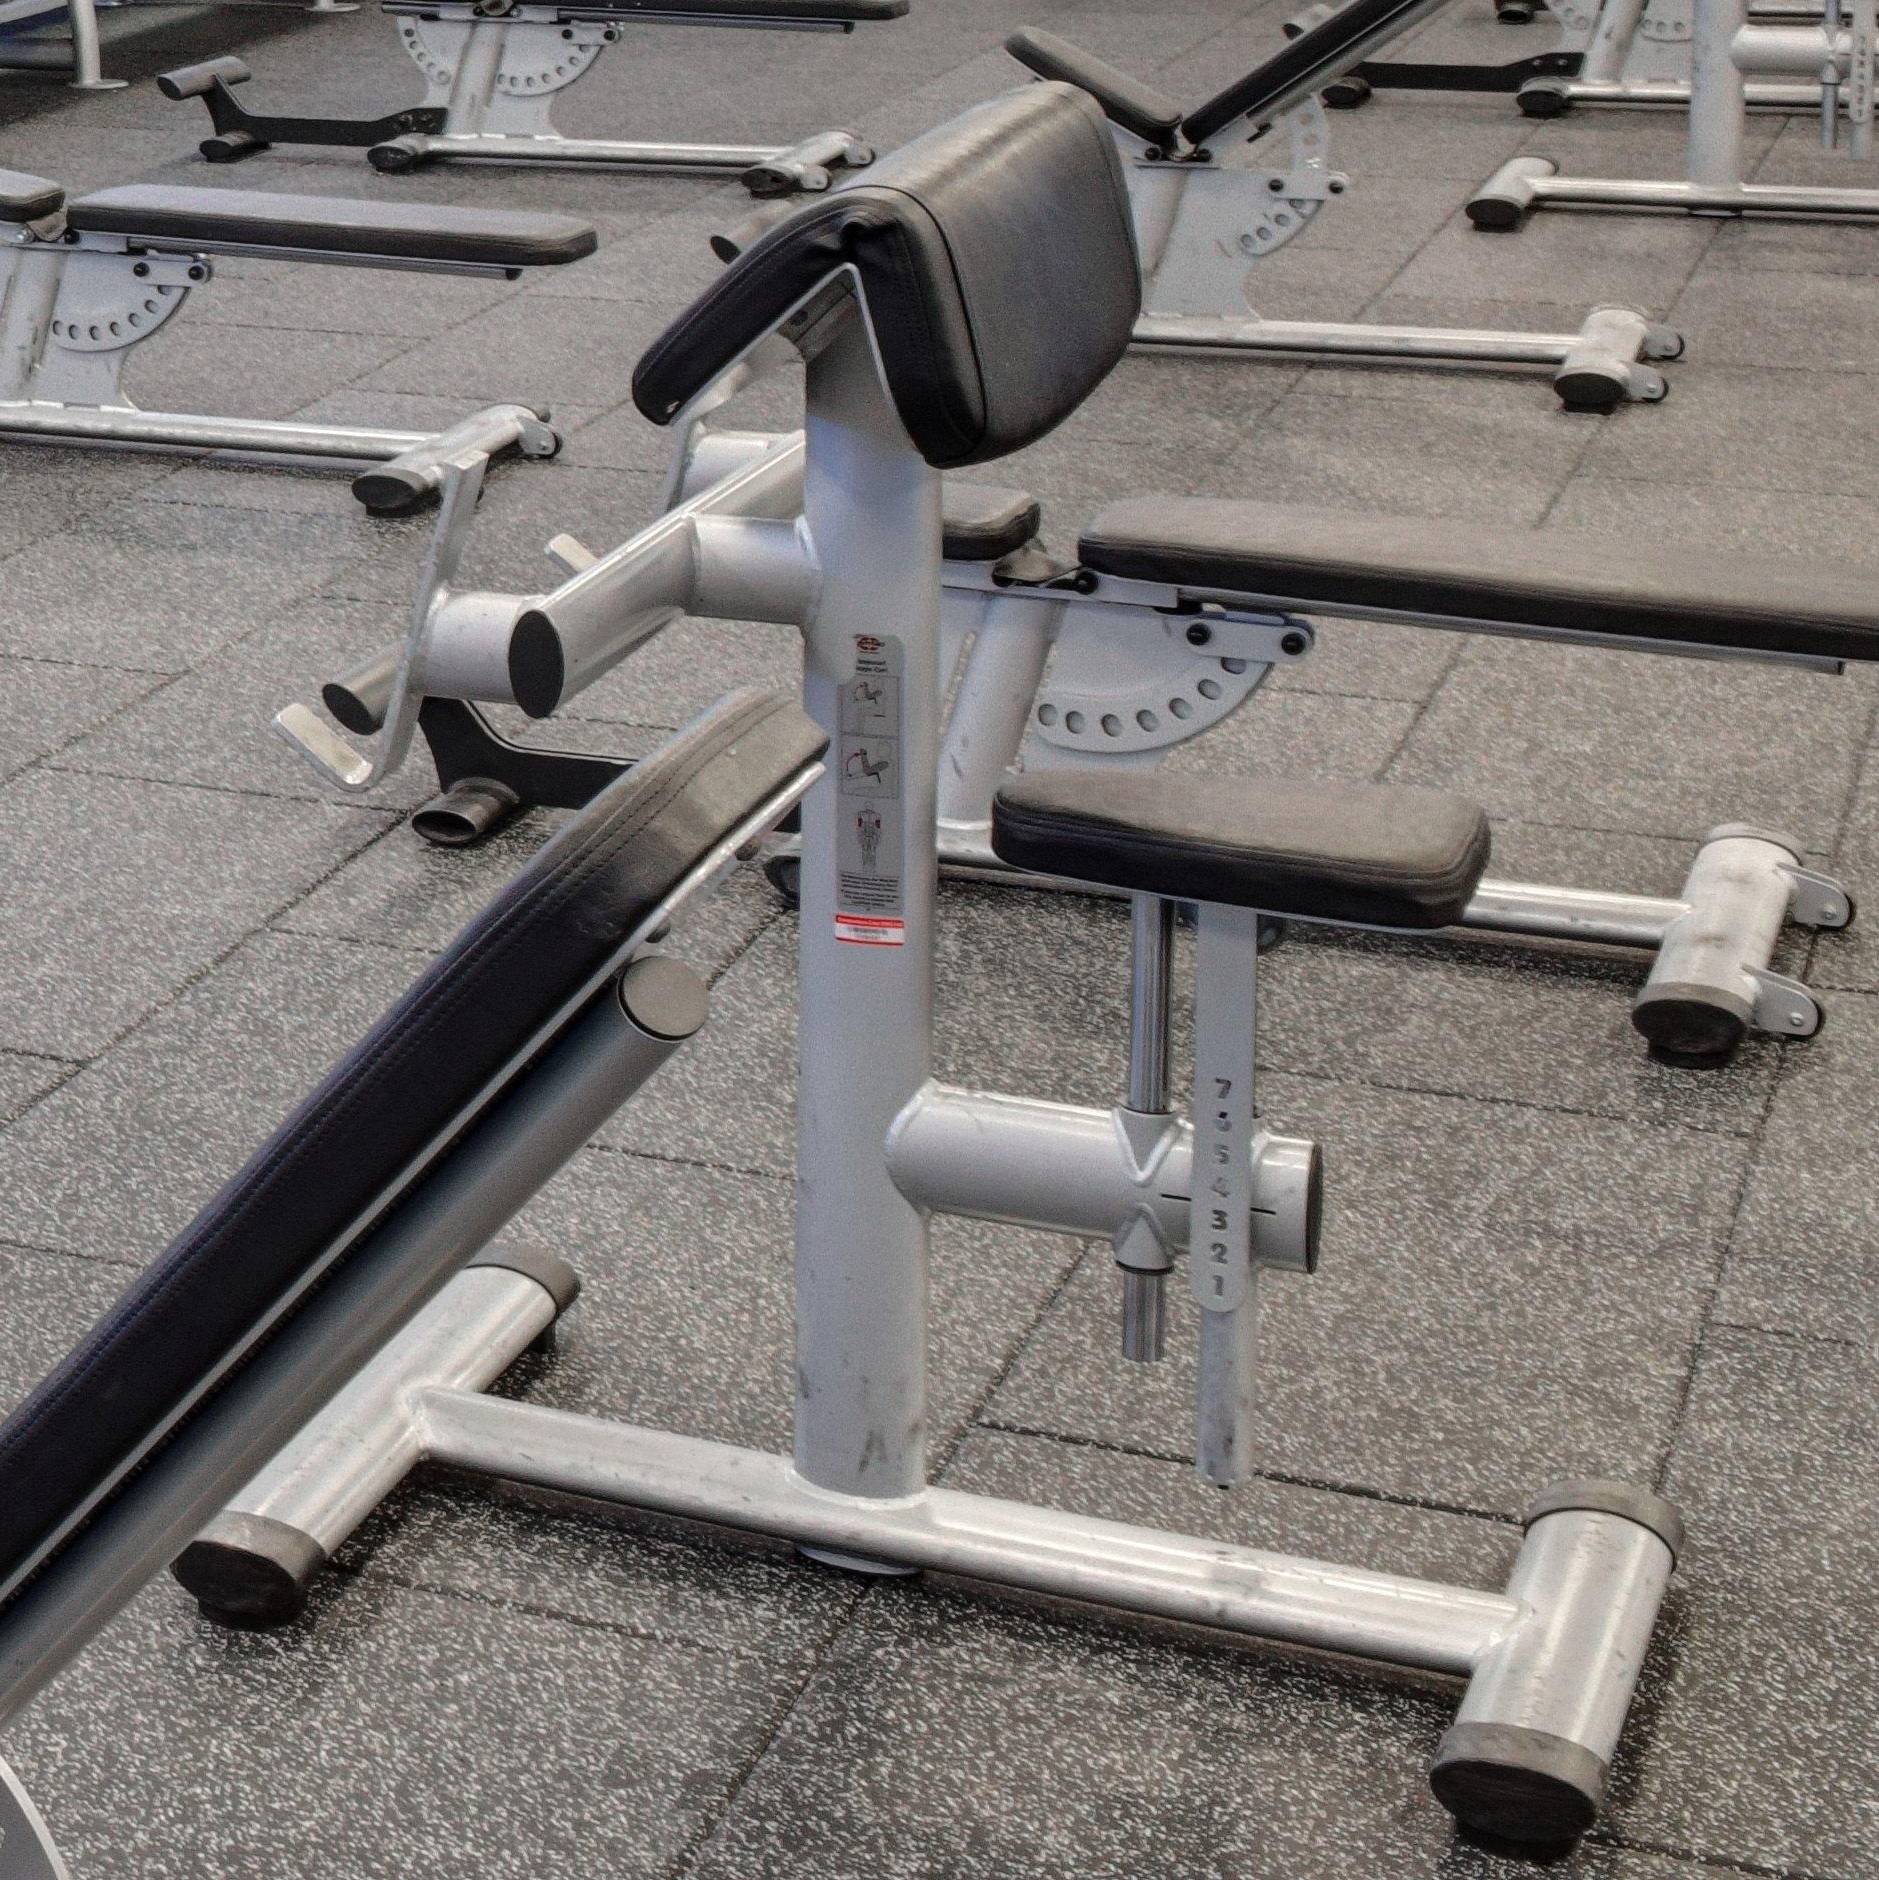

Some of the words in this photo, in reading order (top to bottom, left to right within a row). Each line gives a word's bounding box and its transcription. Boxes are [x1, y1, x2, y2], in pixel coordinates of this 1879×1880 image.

[1215, 1078, 1232, 1099] 7
[1211, 1209, 1228, 1230] 3
[1210, 1242, 1228, 1264] 2
[1213, 1274, 1224, 1296] 1
